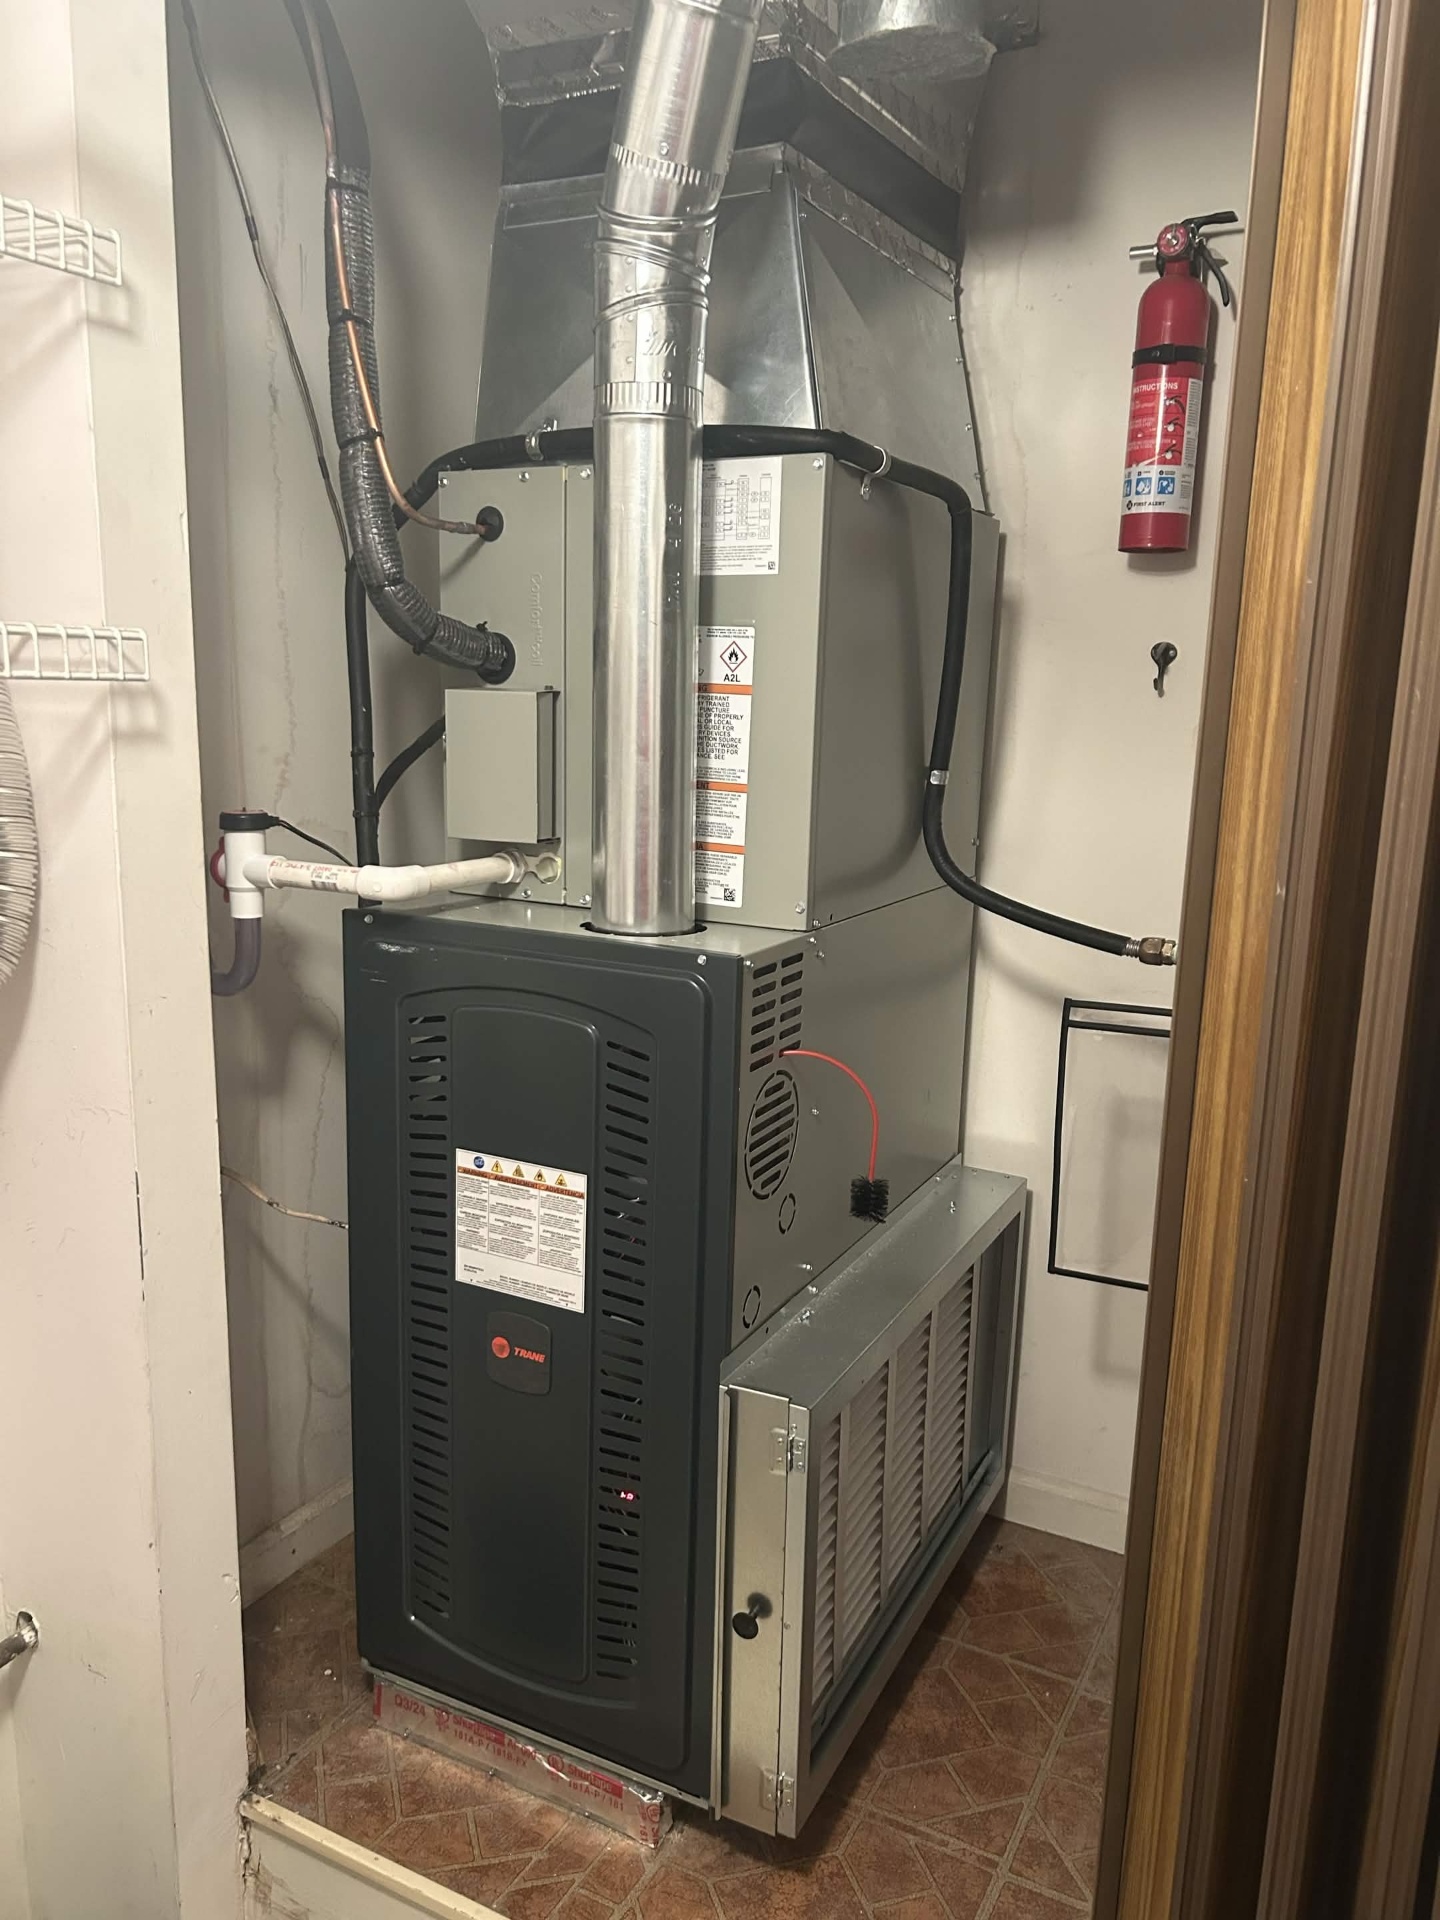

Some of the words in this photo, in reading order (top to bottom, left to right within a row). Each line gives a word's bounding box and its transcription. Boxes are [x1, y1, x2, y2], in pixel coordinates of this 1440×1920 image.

[723, 673, 741, 682] A2L
[514, 1347, 546, 1363] TRANE
[394, 1693, 427, 1718] Q3/24
[567, 1763, 613, 1793] Shurtape
